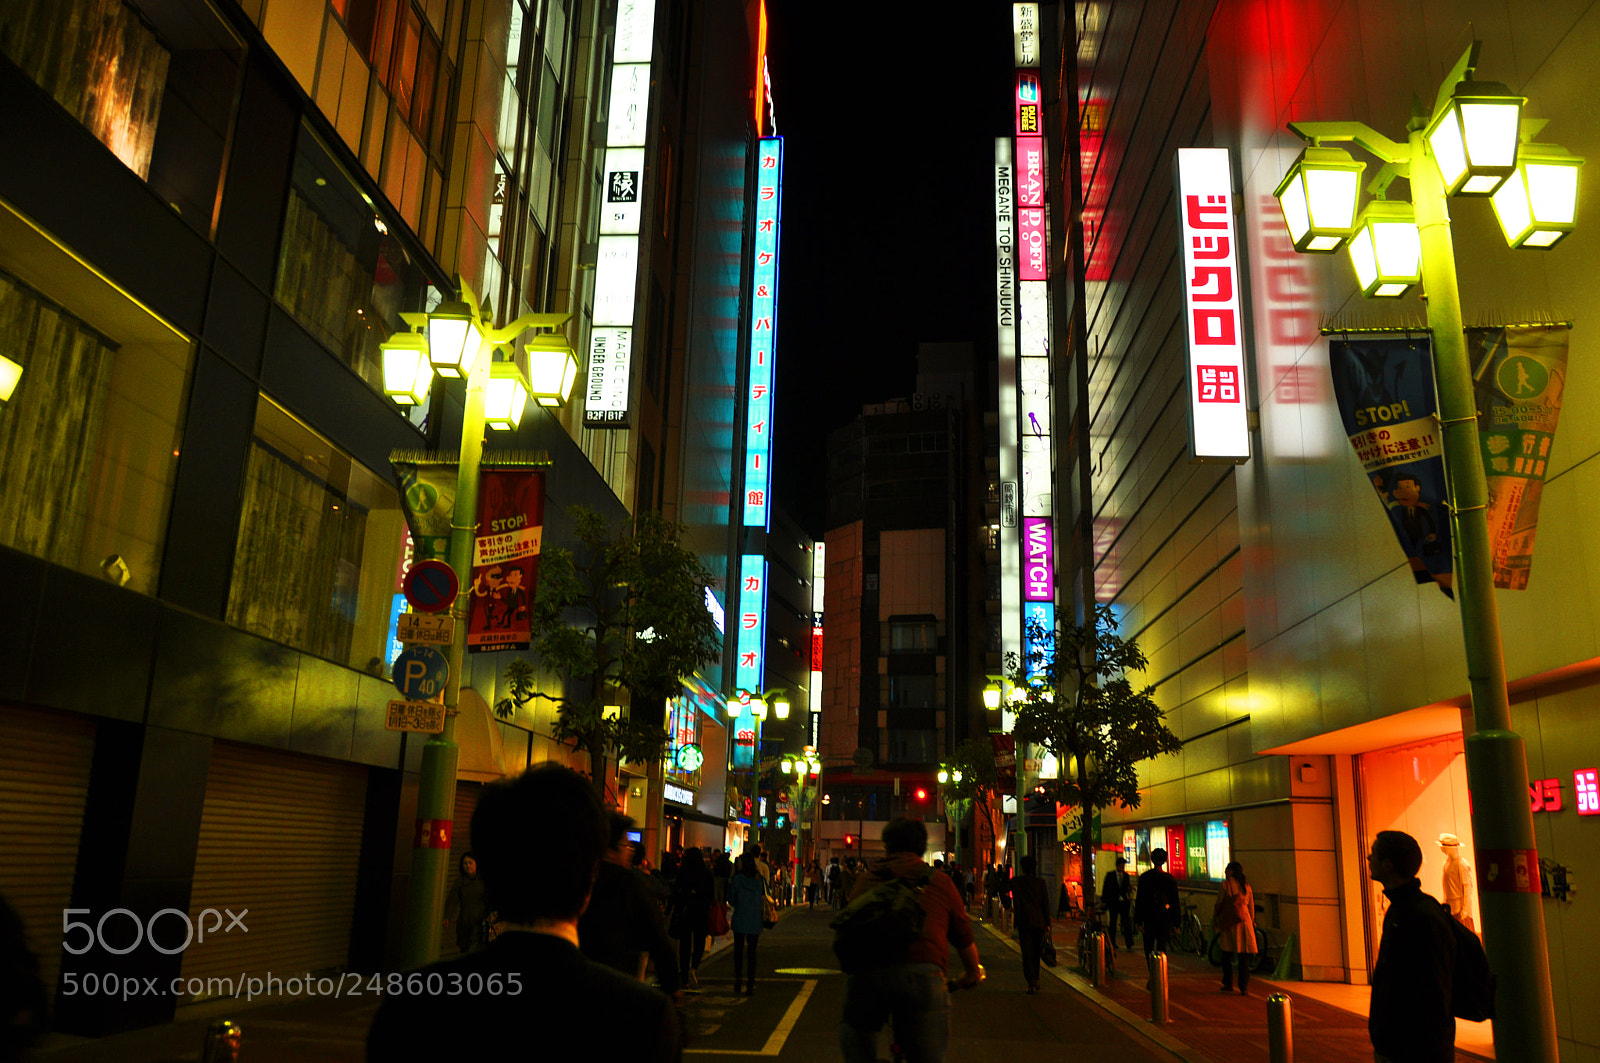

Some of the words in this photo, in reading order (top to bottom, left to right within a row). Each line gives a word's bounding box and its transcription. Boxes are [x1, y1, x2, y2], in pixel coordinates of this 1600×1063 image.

[1021, 106, 1029, 131] FREE
[1028, 106, 1036, 131] DUTY
[998, 167, 1010, 222] MEGANE
[1027, 151, 1041, 226] BRAND
[1020, 184, 1029, 241] TOKYO
[999, 227, 1010, 253] TOP
[1030, 230, 1042, 272] OFF
[1186, 195, 1236, 346] ビックロ
[999, 258, 1012, 327] SHINJUKU
[592, 336, 607, 364] UNDER
[614, 330, 627, 371] MAGIC
[590, 367, 604, 401] GROUND
[586, 412, 604, 421] B2F
[607, 412, 624, 421] B1F
[1355, 400, 1411, 426] STOP!
[491, 513, 528, 532] STOP!
[1029, 522, 1048, 597] WATCH
[404, 660, 427, 693] P
